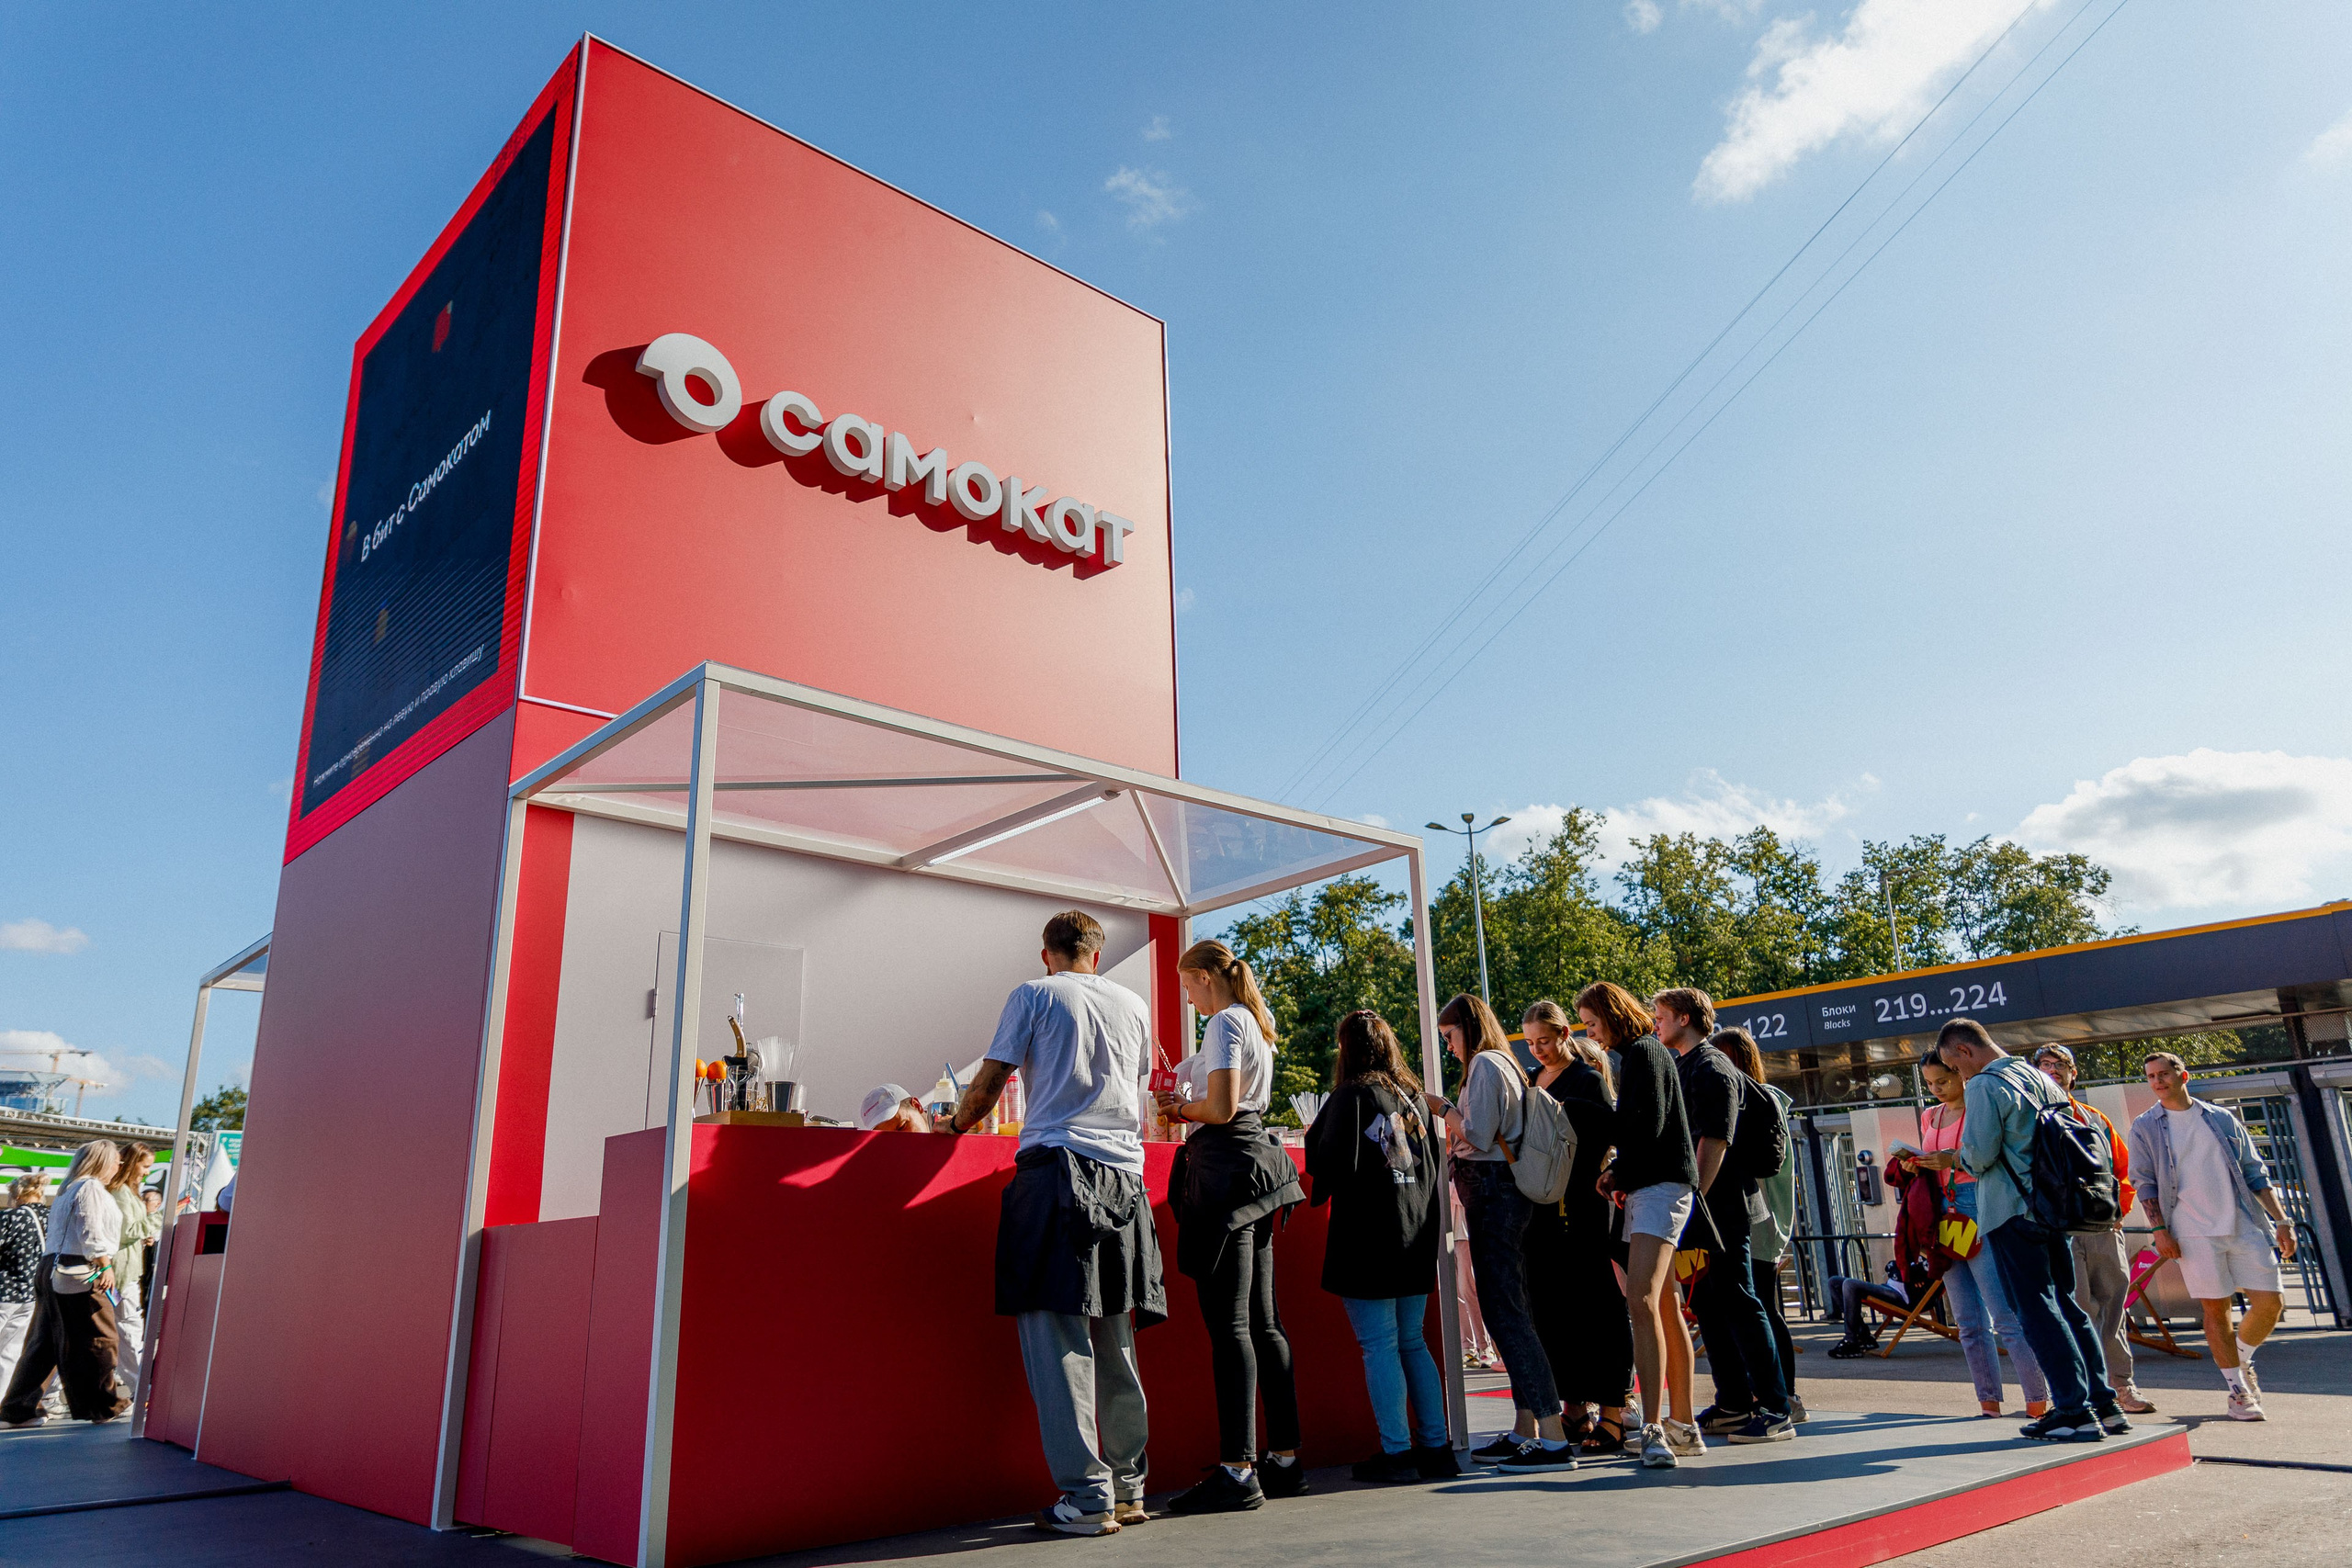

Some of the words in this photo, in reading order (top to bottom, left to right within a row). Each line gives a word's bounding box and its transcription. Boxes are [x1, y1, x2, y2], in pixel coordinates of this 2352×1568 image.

[360, 534, 370, 563] В
[371, 513, 396, 551] бит
[396, 503, 406, 525] с
[407, 409, 492, 513] Самокатом
[760, 389, 1136, 569] самокат
[383, 718, 393, 733] на
[392, 701, 414, 726] левую
[420, 673, 448, 704] правую
[448, 643, 485, 682] клавишу
[1821, 1003, 1857, 1018] Блоки
[1824, 1019, 1851, 1031] Blocks
[1874, 980, 2008, 1024] 219...224
